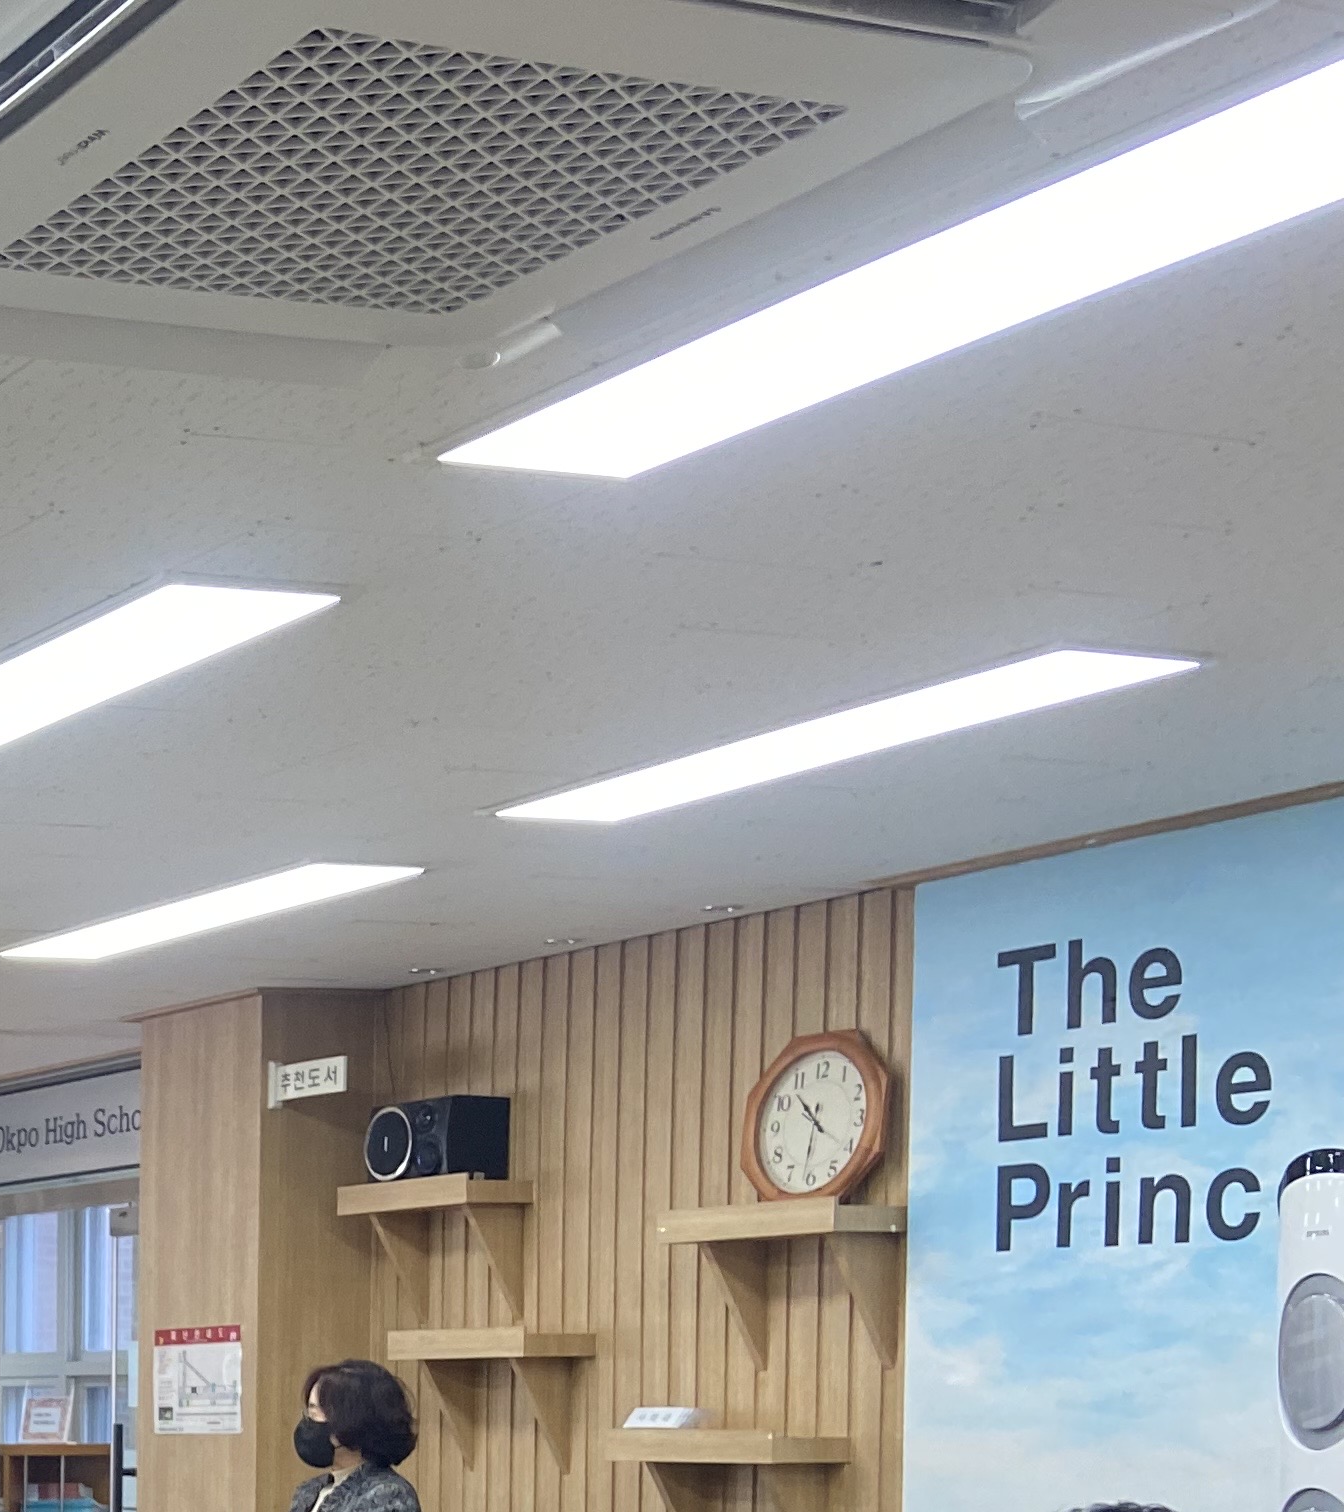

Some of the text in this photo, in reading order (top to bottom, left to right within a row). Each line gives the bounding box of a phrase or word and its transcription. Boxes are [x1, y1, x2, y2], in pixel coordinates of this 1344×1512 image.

[998, 939, 1183, 1036] The
[816, 1060, 830, 1080] 12
[841, 1065, 847, 1083] 1
[281, 1065, 338, 1095] 추천도서
[793, 1071, 805, 1090] 11
[998, 1034, 1273, 1142] Little
[853, 1083, 863, 1101] 2
[776, 1094, 792, 1112] 10
[770, 1120, 781, 1133] 9
[853, 1108, 865, 1127] 3
[44, 1112, 88, 1146] High
[772, 1145, 783, 1164] 8
[843, 1137, 853, 1154] 4
[786, 1164, 796, 1183] 7
[827, 1159, 839, 1178] 5
[805, 1173, 816, 1187] 6
